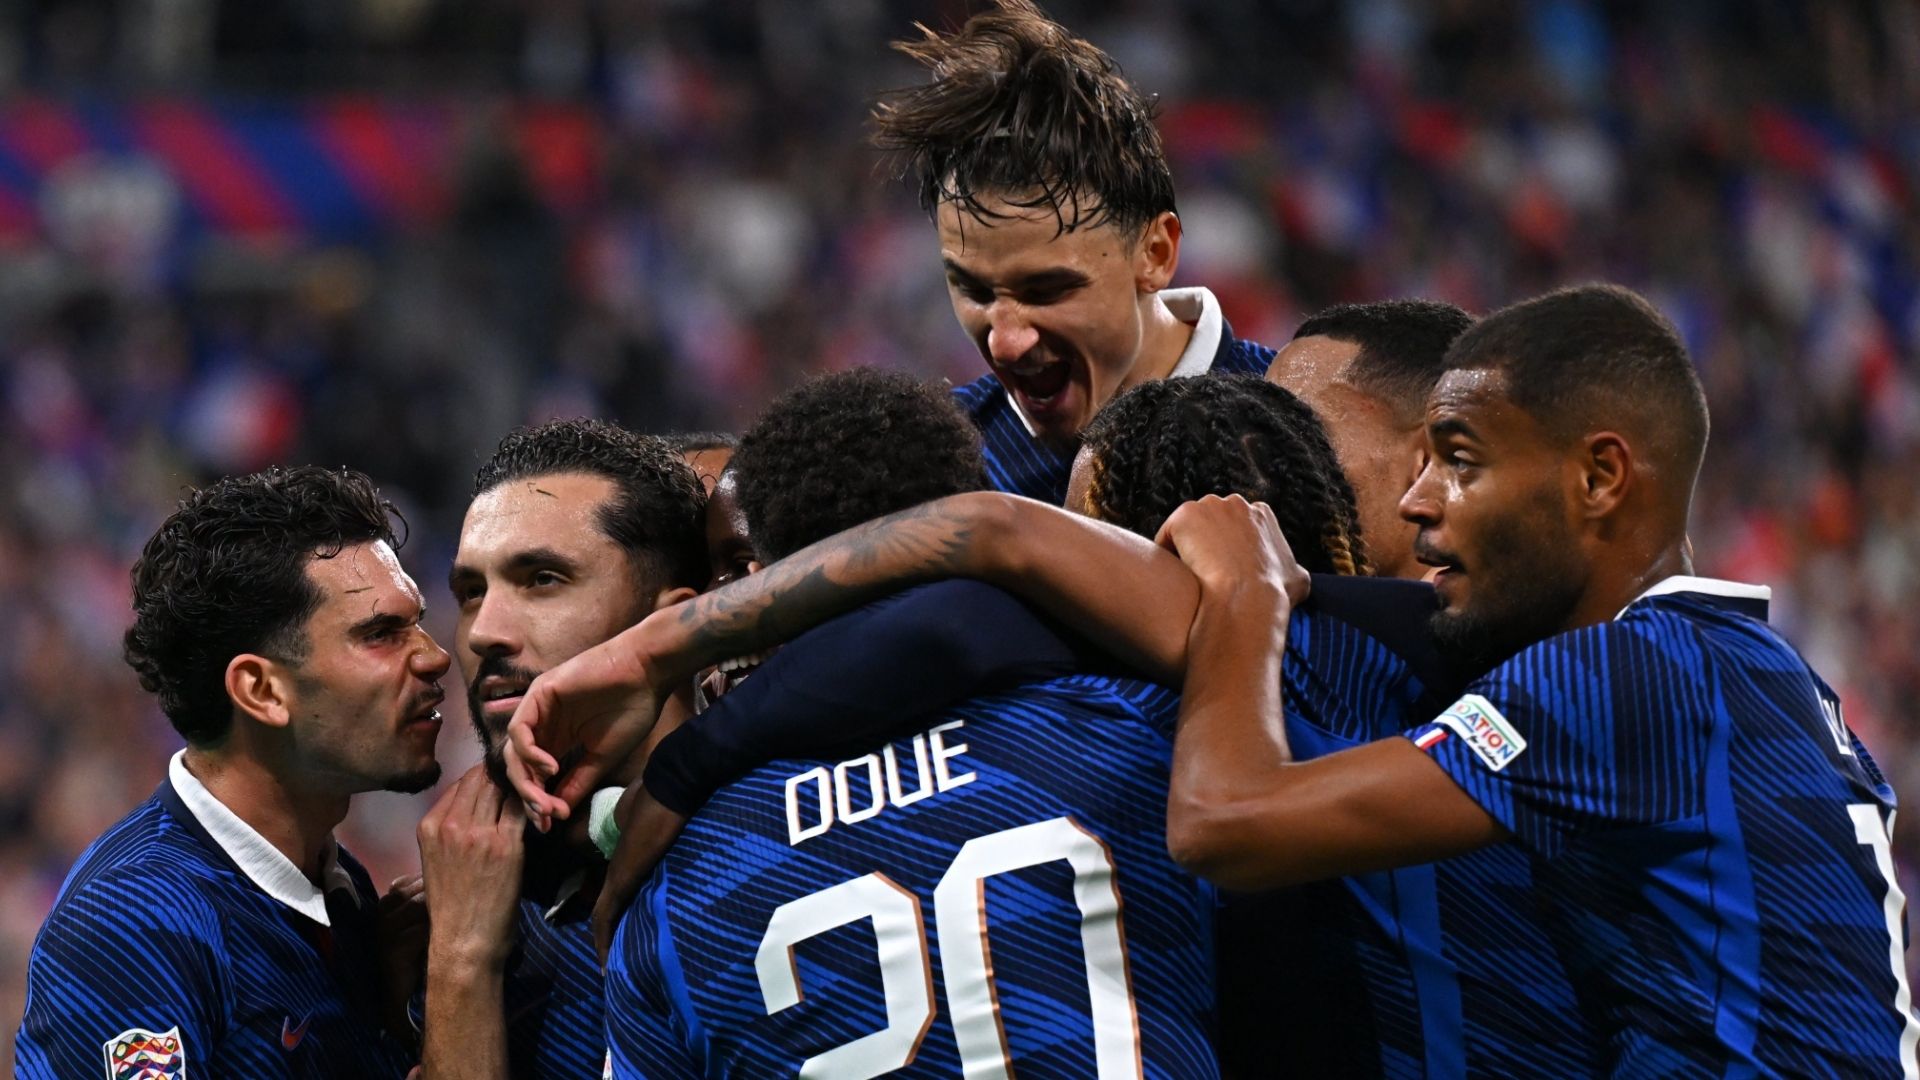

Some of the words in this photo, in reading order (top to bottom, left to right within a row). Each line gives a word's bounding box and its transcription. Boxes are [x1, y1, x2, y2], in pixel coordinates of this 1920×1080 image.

[785, 719, 977, 846] DOUE
[754, 815, 1144, 1080] 20
[1846, 803, 1920, 1080] 1
